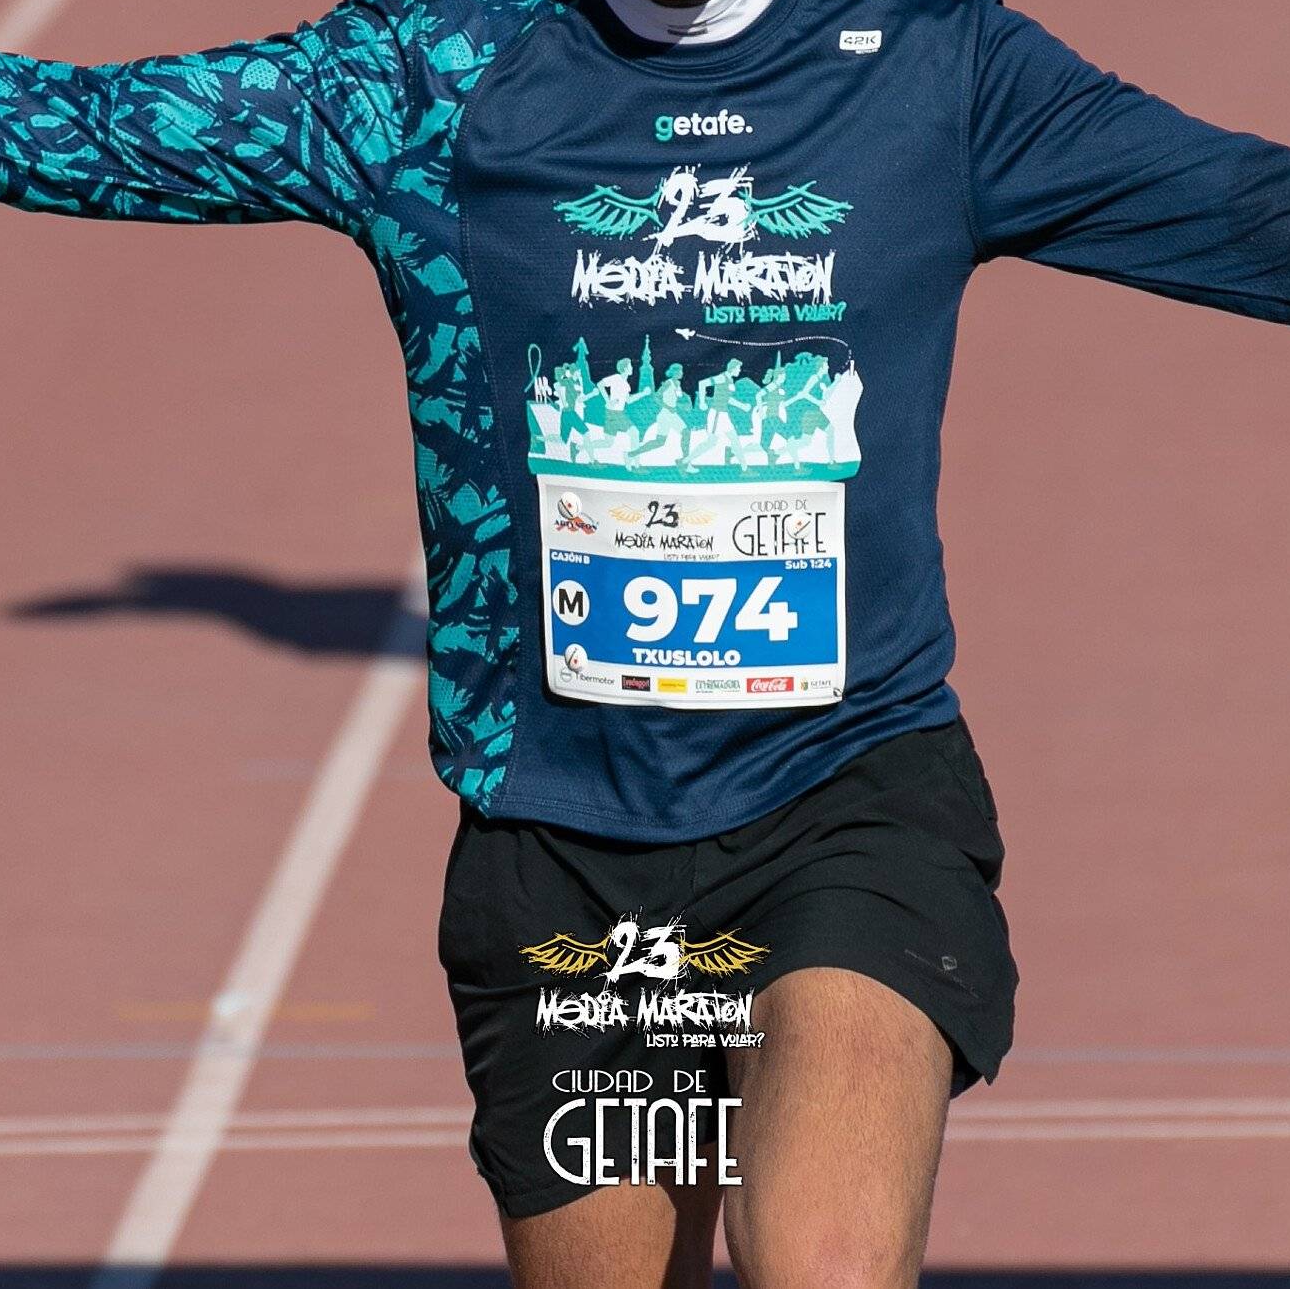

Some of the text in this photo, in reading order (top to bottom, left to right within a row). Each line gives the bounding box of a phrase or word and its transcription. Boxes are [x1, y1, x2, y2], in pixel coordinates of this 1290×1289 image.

[655, 109, 753, 142] getafe.
[654, 164, 759, 248] 23
[693, 250, 836, 305] MARATON
[645, 500, 679, 528] 23
[660, 533, 714, 551] MARATON
[785, 560, 808, 570] Sub
[558, 576, 798, 643] M 974
[632, 648, 741, 667] TXUSLOLO
